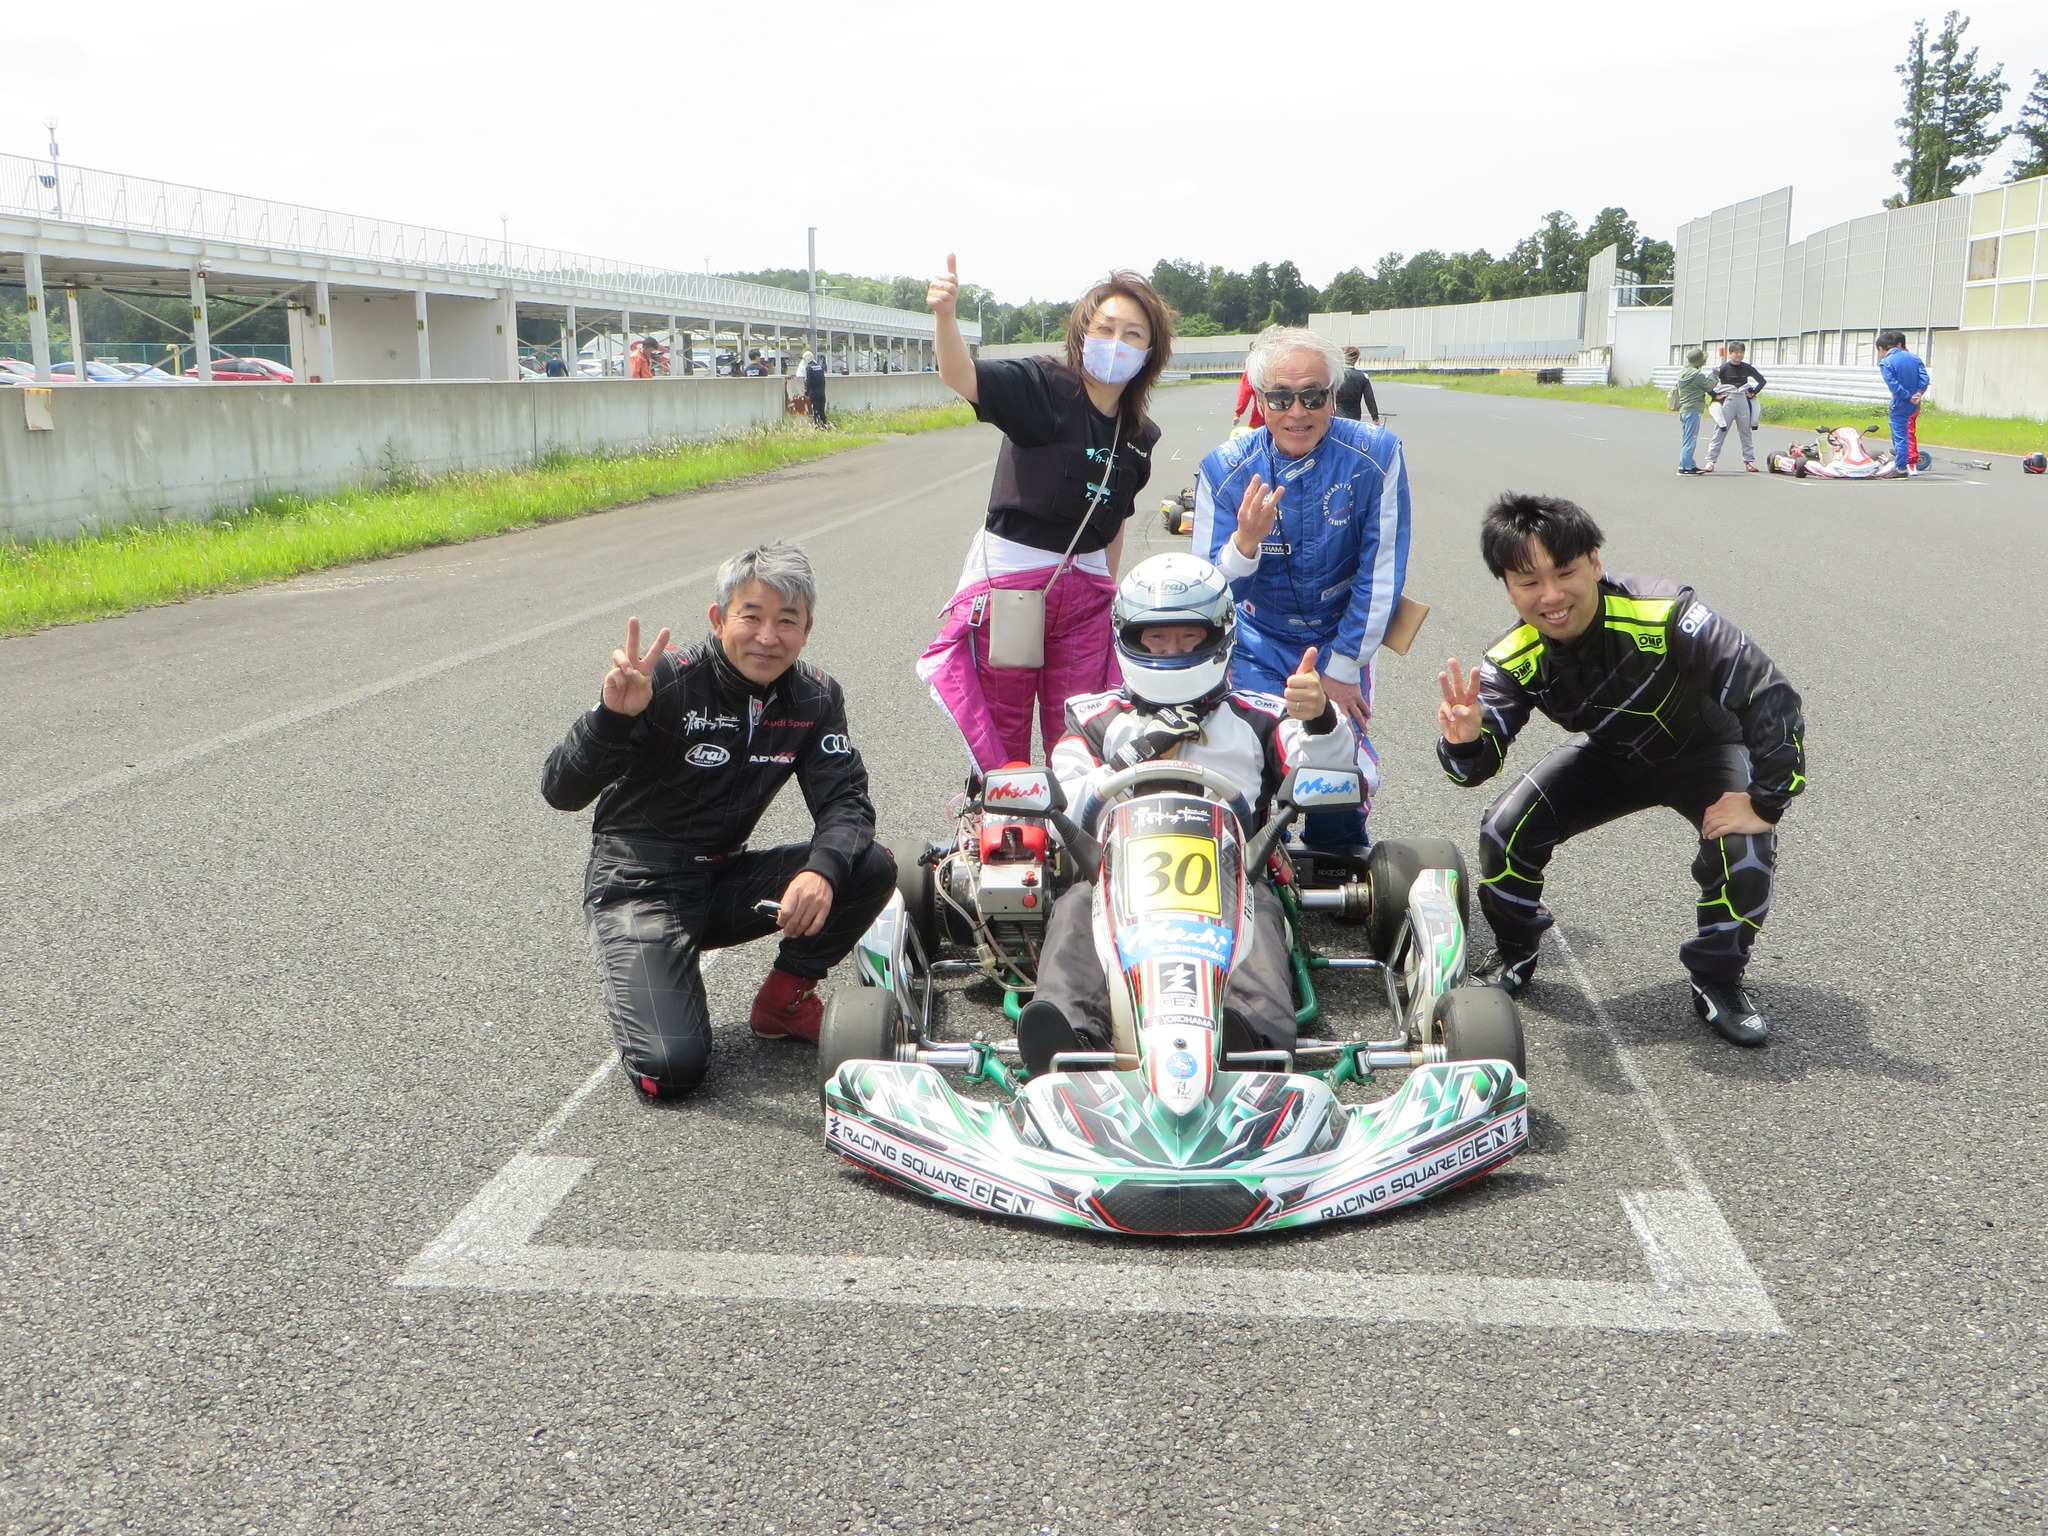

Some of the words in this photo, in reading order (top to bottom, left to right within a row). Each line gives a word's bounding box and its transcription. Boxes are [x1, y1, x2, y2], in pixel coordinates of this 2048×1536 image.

[1681, 604, 1709, 634] OMP
[1638, 635, 1662, 648] OMP
[1511, 662, 1532, 680] OMP
[1078, 702, 1102, 713] OMP
[1254, 699, 1279, 709] OMP
[763, 719, 786, 727] Audi
[788, 719, 814, 728] Sport
[689, 746, 726, 761] Arai
[1142, 852, 1212, 897] 30
[1161, 1015, 1213, 1029] YOKOHAMA
[842, 1125, 897, 1161] RACING
[901, 1151, 970, 1193] SQUARE
[971, 1177, 1034, 1216] GEN
[1320, 1185, 1387, 1219] RACING
[1390, 1153, 1458, 1194] SQUARE
[1458, 1123, 1508, 1166] GEN
